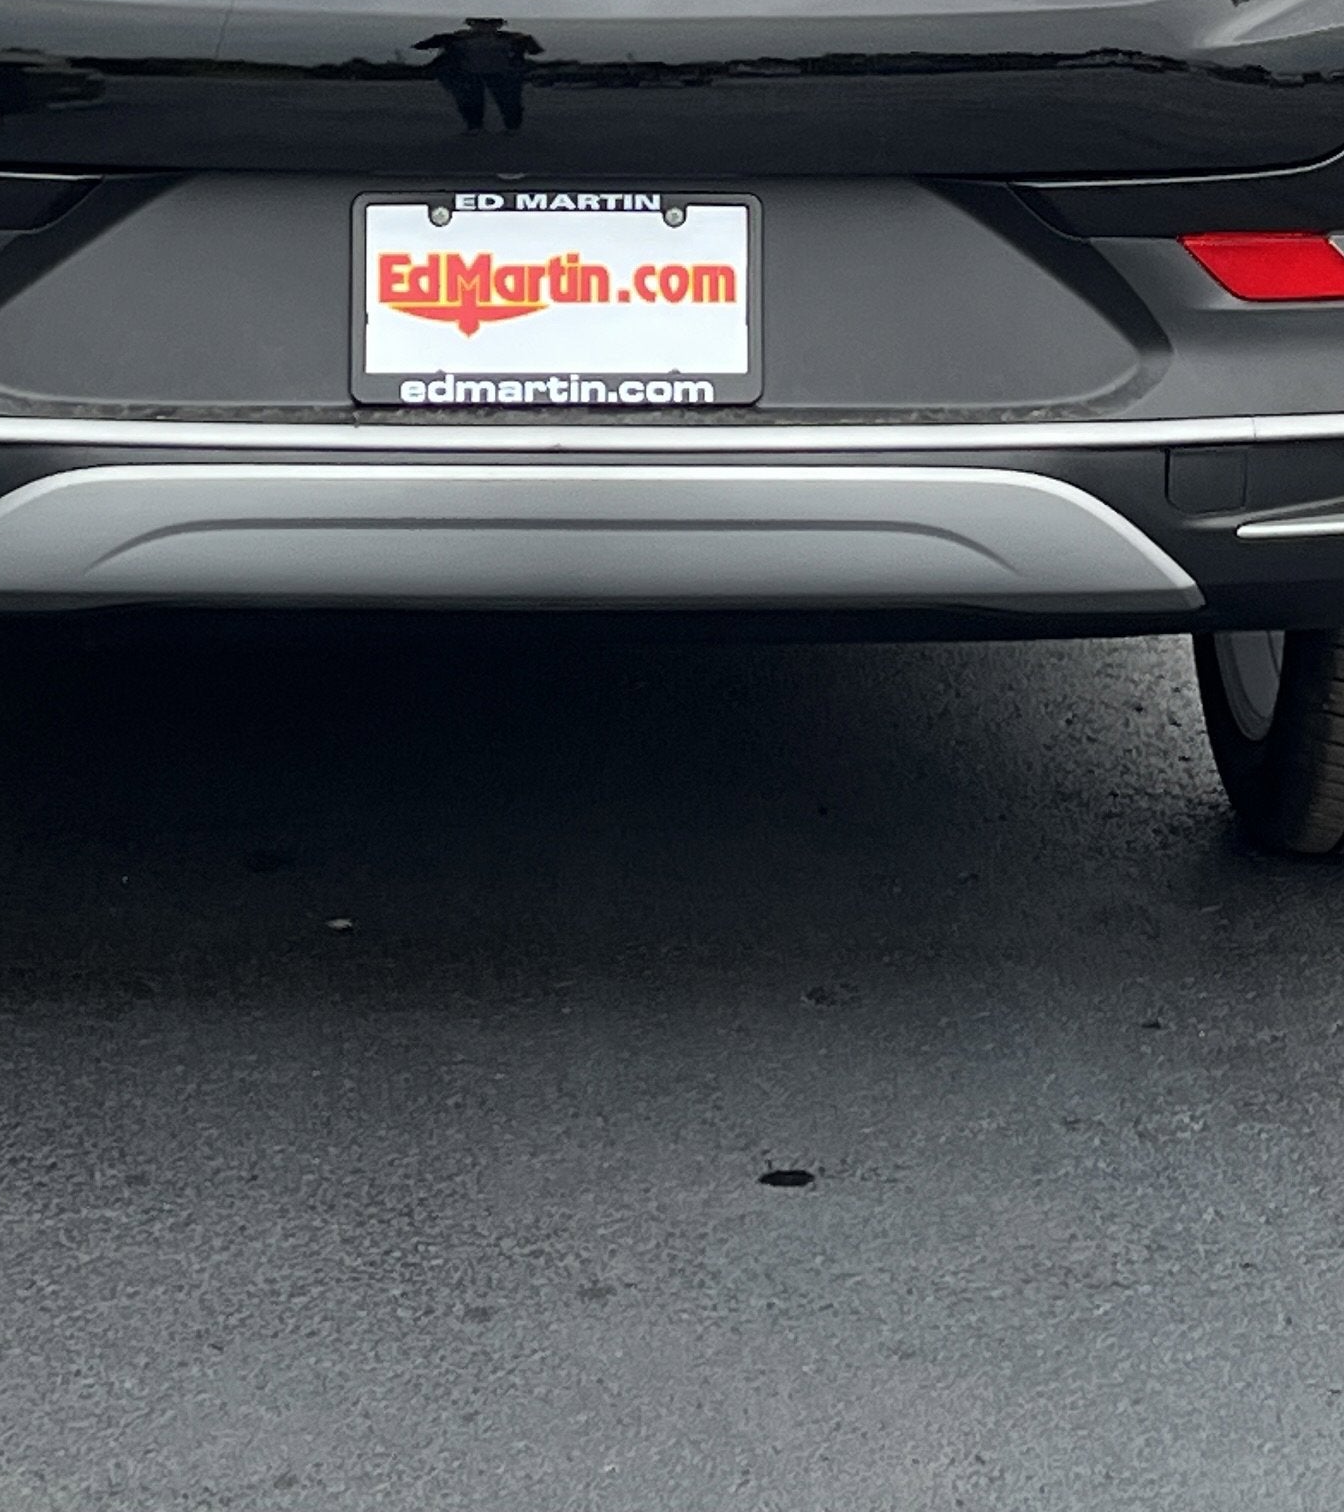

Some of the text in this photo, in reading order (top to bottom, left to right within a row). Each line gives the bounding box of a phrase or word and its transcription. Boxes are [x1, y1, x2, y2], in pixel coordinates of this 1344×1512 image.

[456, 194, 661, 211] ED MARTIN
[400, 375, 714, 404] edmartin.com
